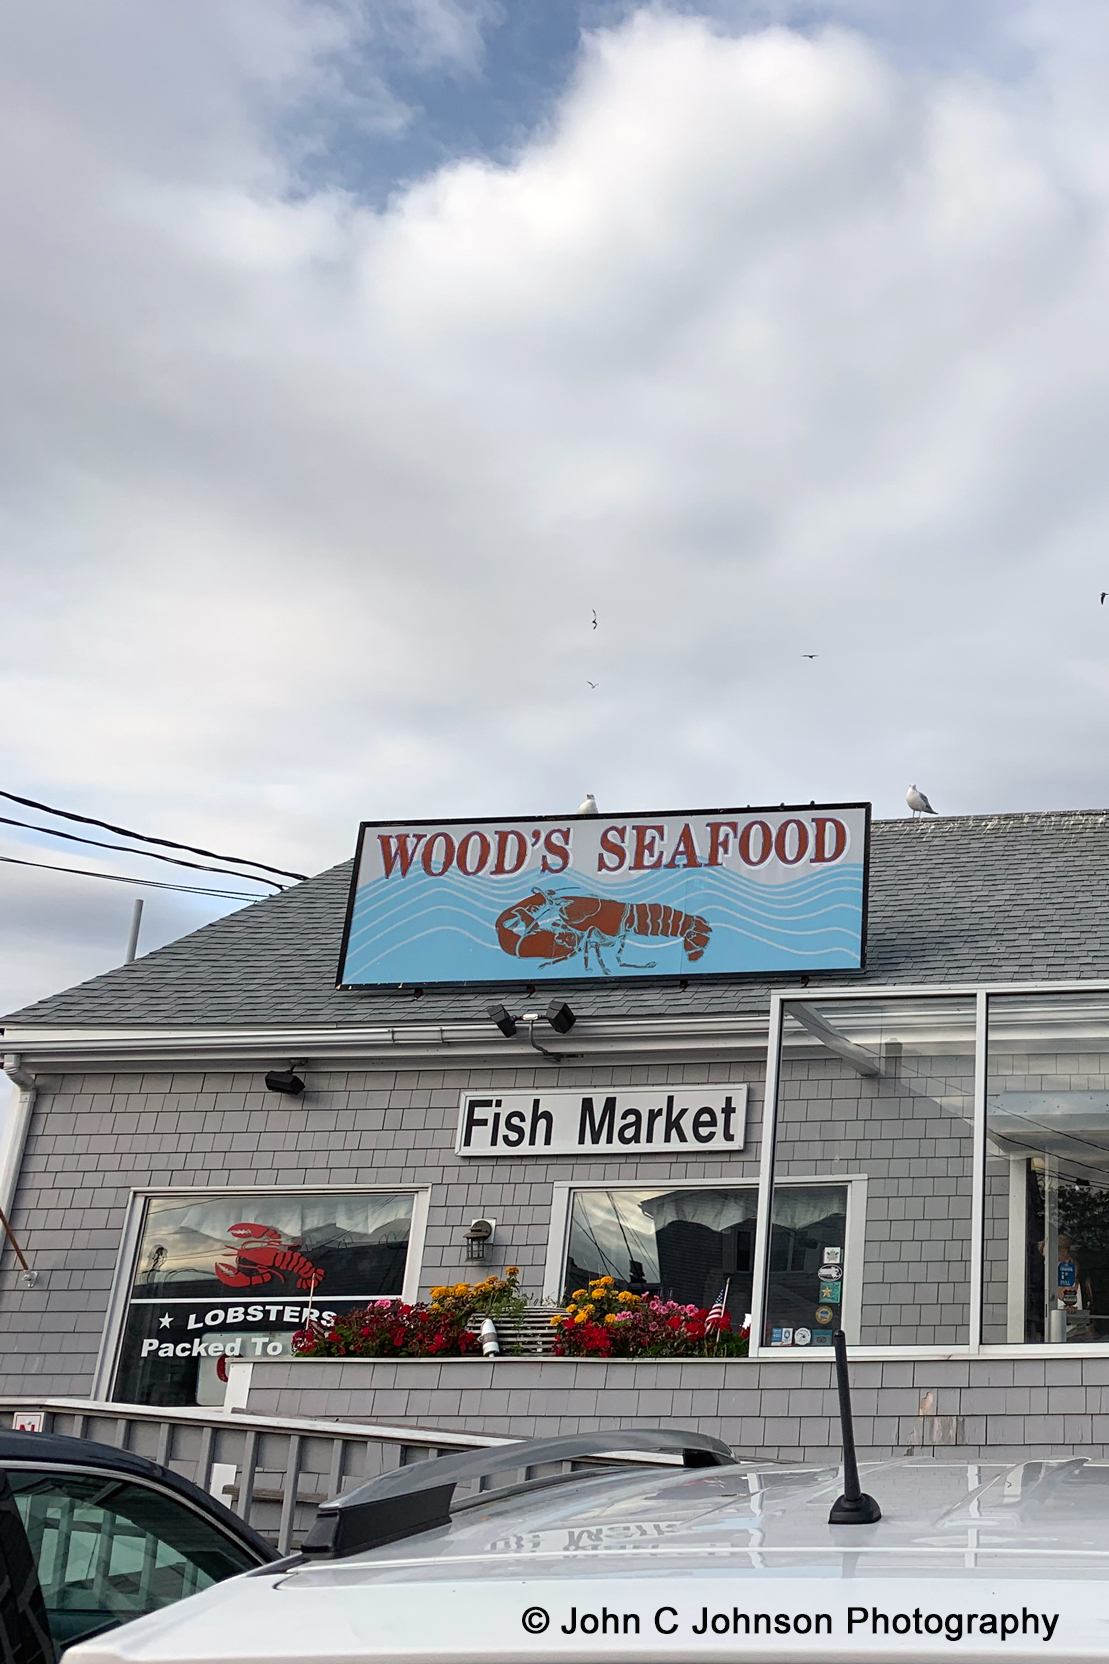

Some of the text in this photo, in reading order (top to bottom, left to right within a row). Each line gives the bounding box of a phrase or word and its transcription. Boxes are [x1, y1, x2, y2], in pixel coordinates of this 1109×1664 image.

[376, 817, 848, 878] WOOD'S SEAFOOD
[463, 1095, 736, 1147] Fish Market
[187, 1305, 337, 1330] LOBSTERS
[140, 1337, 283, 1357] Packed To
